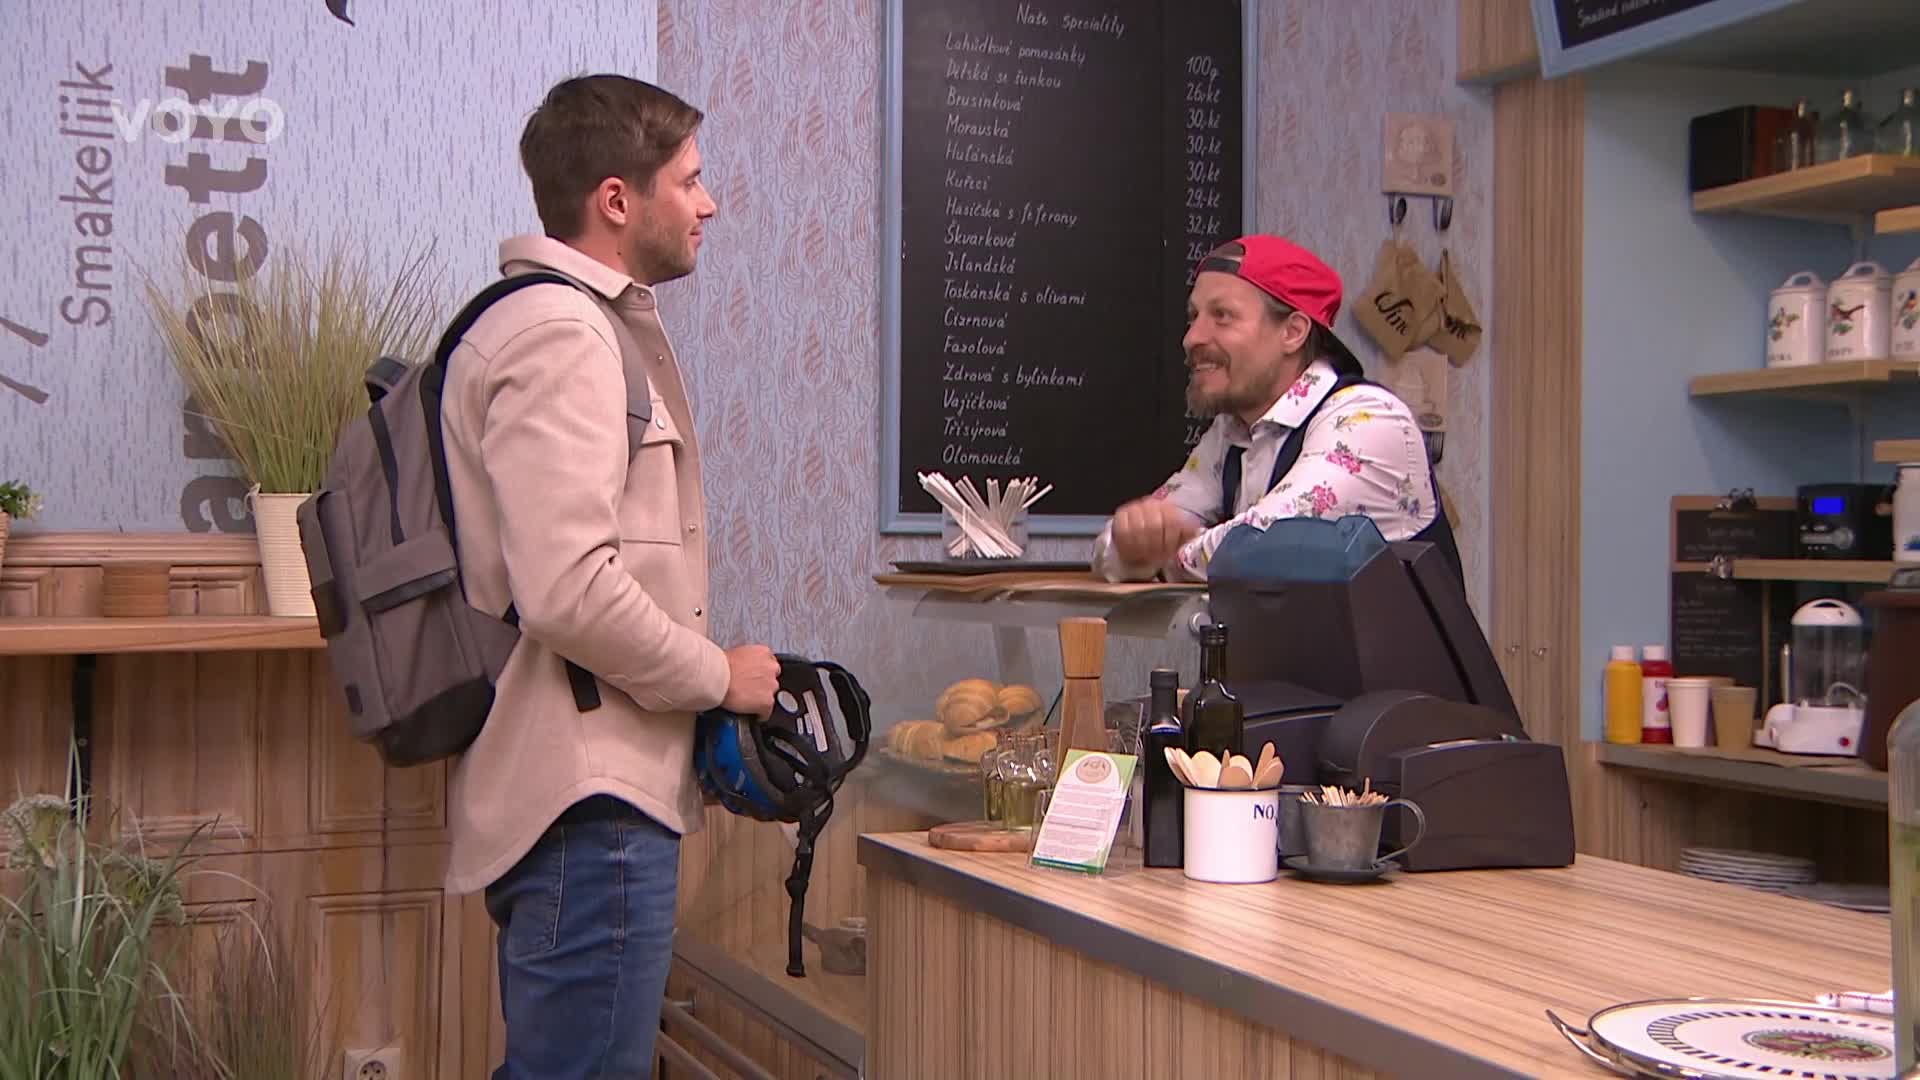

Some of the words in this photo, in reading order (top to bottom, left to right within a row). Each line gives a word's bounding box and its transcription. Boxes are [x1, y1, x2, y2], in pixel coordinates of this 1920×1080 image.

[1063, 14, 1125, 39] speciality
[1018, 43, 1086, 66] pomazánky
[996, 72, 1008, 84] se
[1015, 67, 1062, 89] šunkou
[1185, 55, 1218, 81] 100g
[947, 85, 1024, 112] Brusinková
[945, 114, 1011, 138] Moravská
[945, 196, 1002, 218] Hasičská
[1008, 208, 1013, 220] s
[1021, 202, 1077, 227] feferony
[944, 219, 1017, 249] Škvarková
[944, 251, 1016, 274] Islandská
[944, 279, 1012, 301] Toskánská
[1020, 291, 1028, 304] s
[1036, 285, 1087, 305] olivami
[944, 306, 1008, 328] Cizrnová
[943, 335, 1007, 355] Fazolová
[943, 361, 995, 382] Zdravá
[1001, 372, 1009, 384] s
[1016, 365, 1087, 389] bylinkami
[943, 388, 1010, 416] Vajíčková
[942, 444, 1023, 465] Olomoucká
